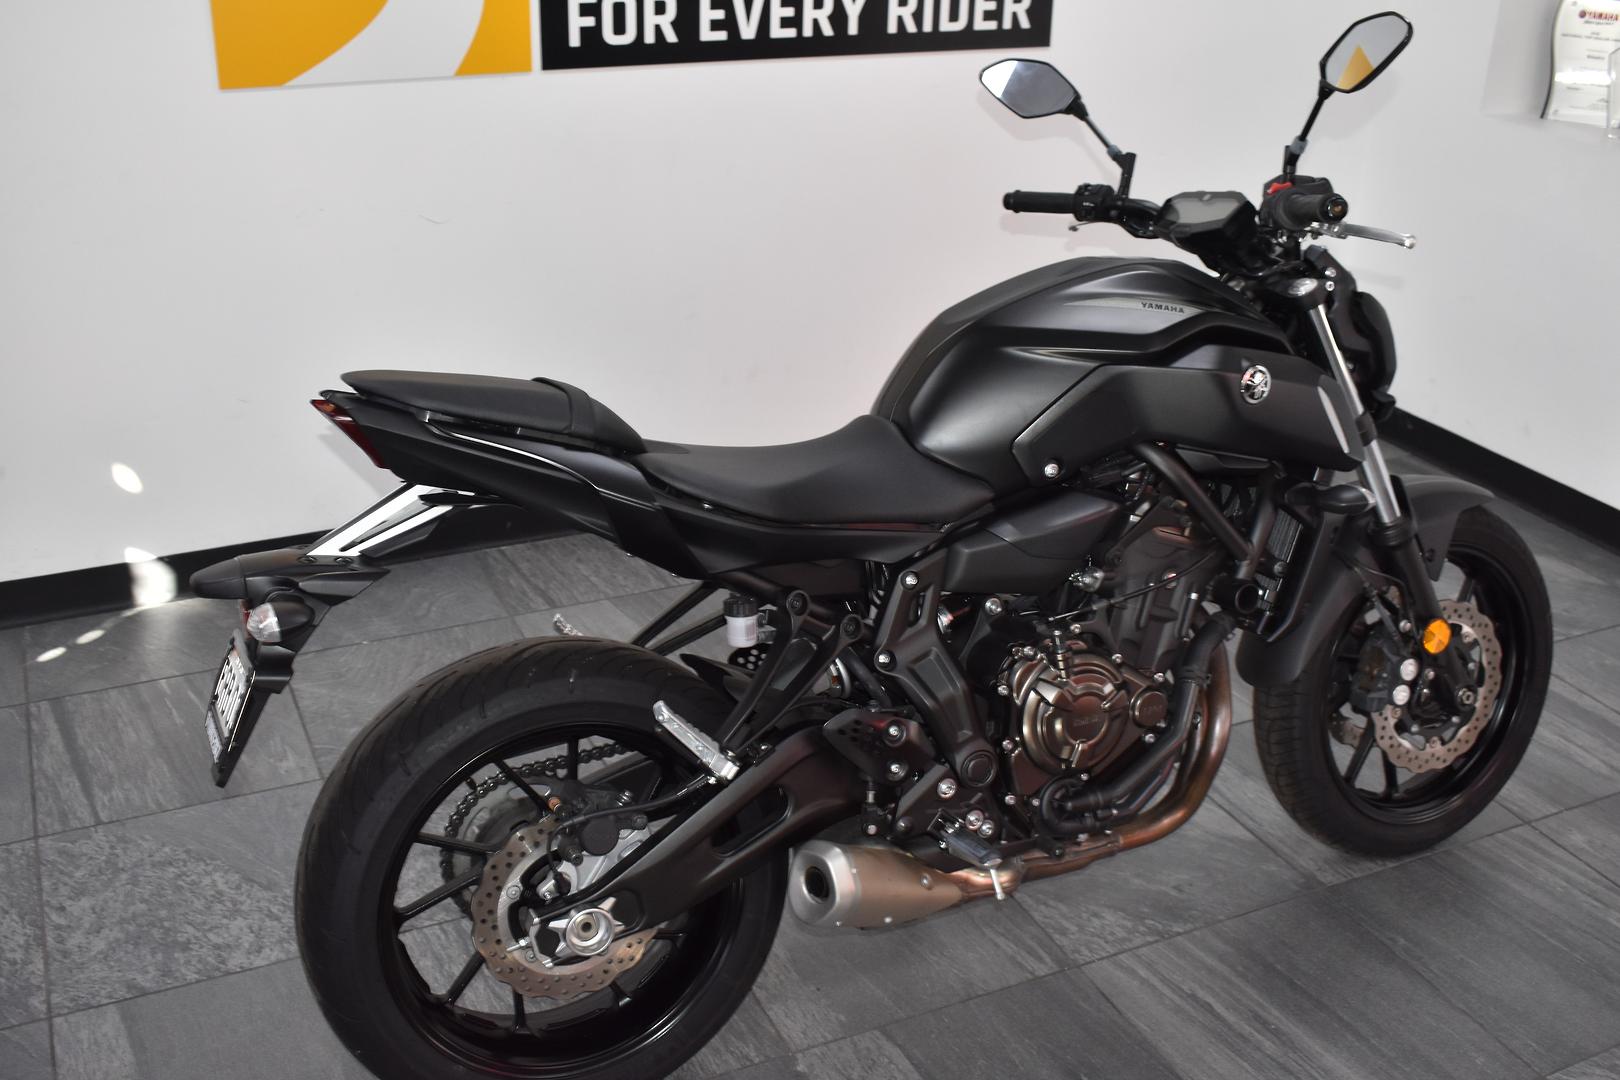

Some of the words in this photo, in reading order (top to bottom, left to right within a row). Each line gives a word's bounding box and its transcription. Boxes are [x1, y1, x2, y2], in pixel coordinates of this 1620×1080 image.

[568, 0, 680, 48] FOR
[699, 0, 866, 42] EVERY
[887, 0, 1032, 34] RIDER
[1141, 301, 1184, 313] YAMAHA
